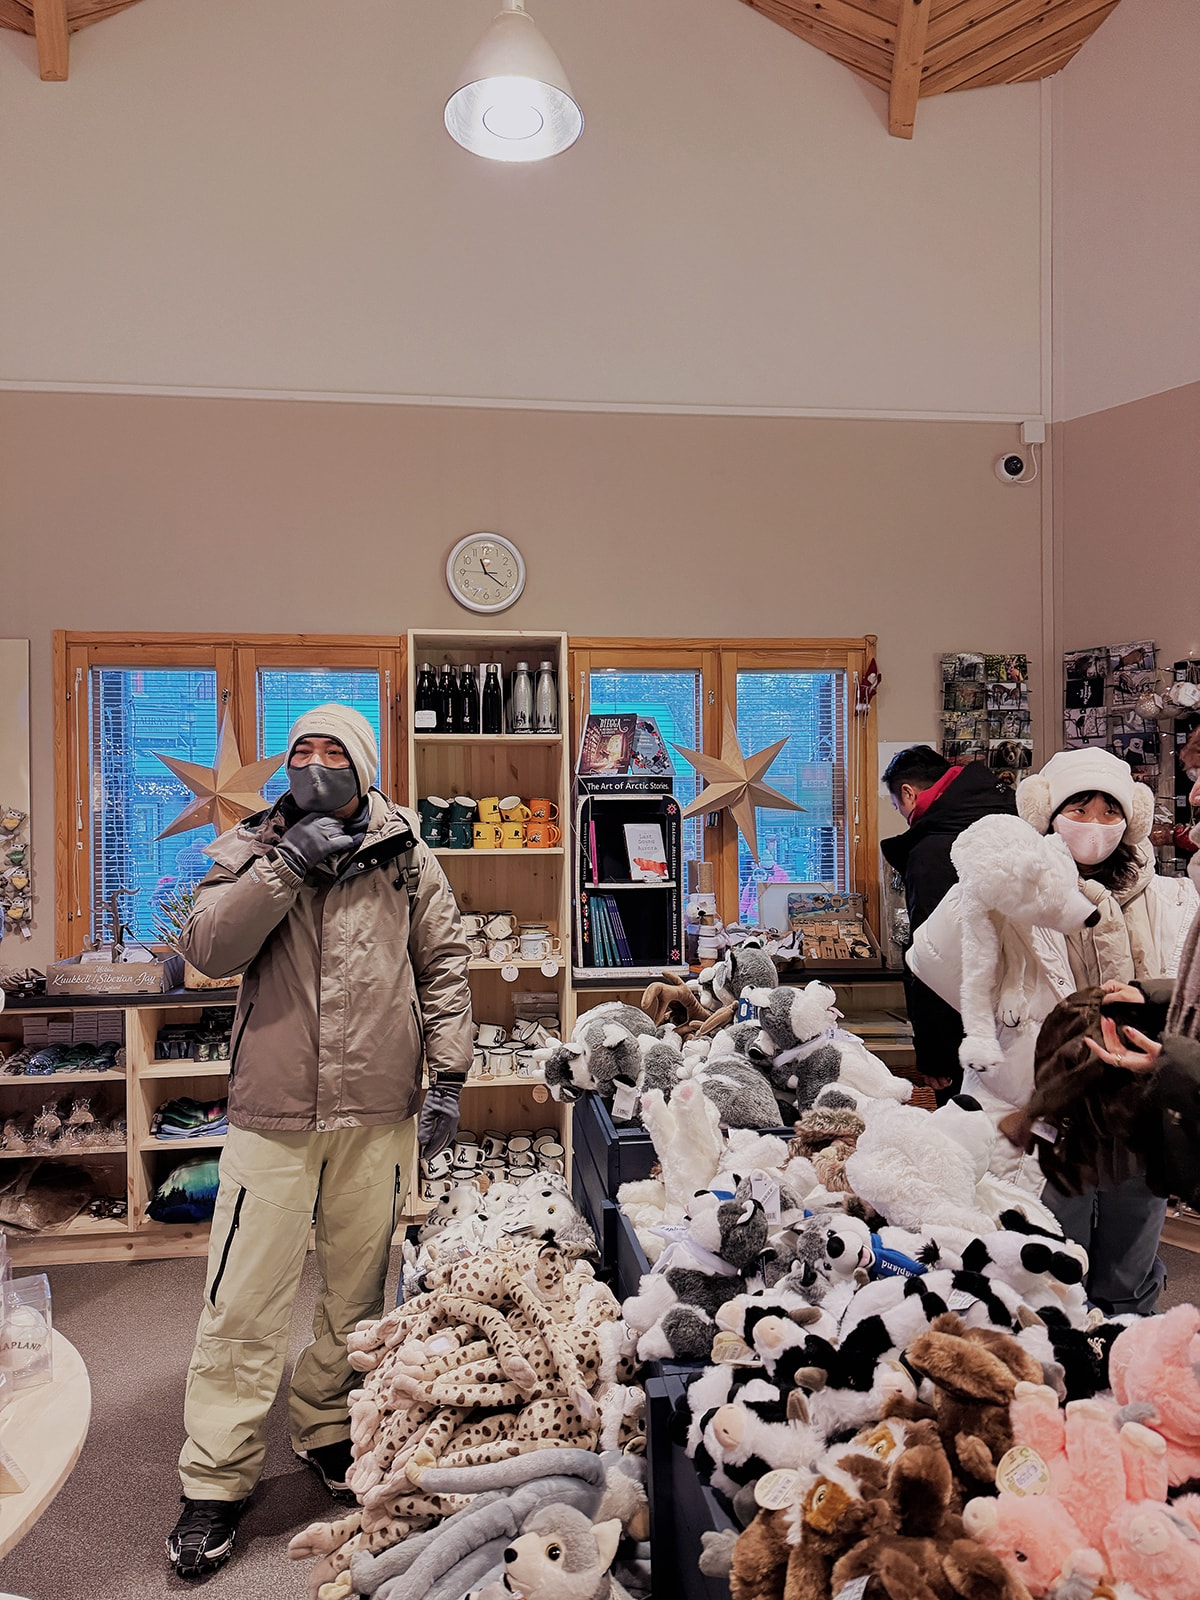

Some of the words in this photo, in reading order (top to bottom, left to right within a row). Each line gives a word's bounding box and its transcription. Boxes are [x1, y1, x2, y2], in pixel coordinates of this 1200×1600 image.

[472, 548, 478, 557] 11
[496, 548, 499, 556] 1
[463, 556, 472, 566] 10
[502, 556, 508, 566] 2
[460, 568, 466, 576] 9
[506, 569, 512, 578] 3
[464, 579, 470, 588] 8
[482, 592, 490, 600] 6
[496, 588, 500, 598] 5
[587, 782, 600, 790] The
[614, 782, 624, 790] of
[625, 782, 649, 790] Arctic
[96, 972, 134, 985] Siberian
[134, 971, 156, 986] Jay
[881, 1260, 917, 1278] apland
